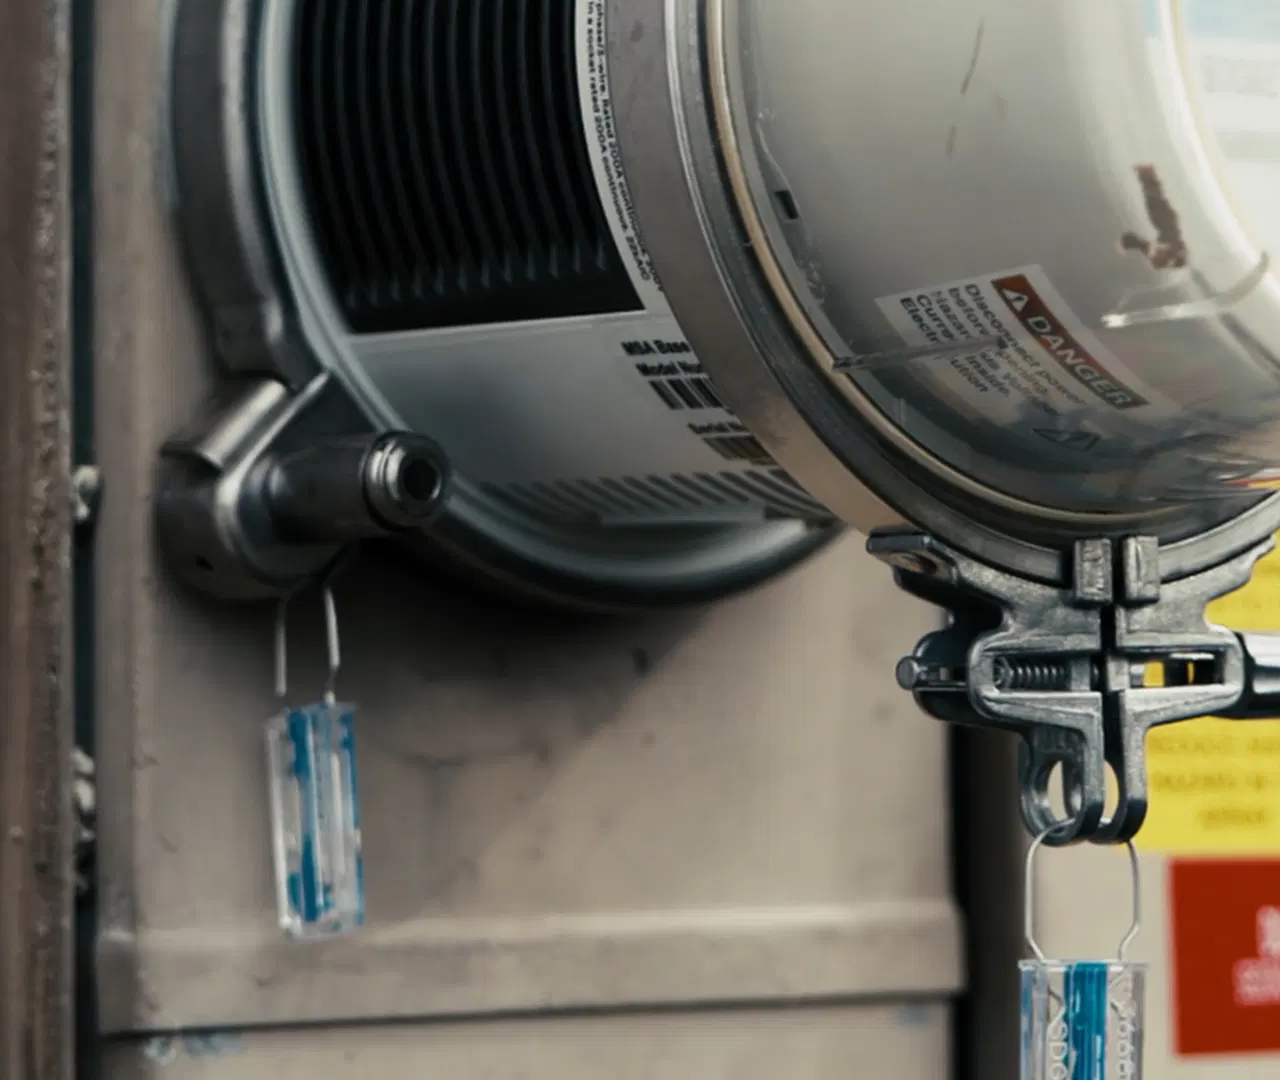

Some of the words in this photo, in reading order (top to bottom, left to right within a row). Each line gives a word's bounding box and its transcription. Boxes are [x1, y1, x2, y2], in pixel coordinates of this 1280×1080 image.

[594, 115, 607, 154] 200A
[652, 339, 692, 355] Base
[964, 283, 1040, 368] Disconnect
[1029, 315, 1133, 408] DANGER
